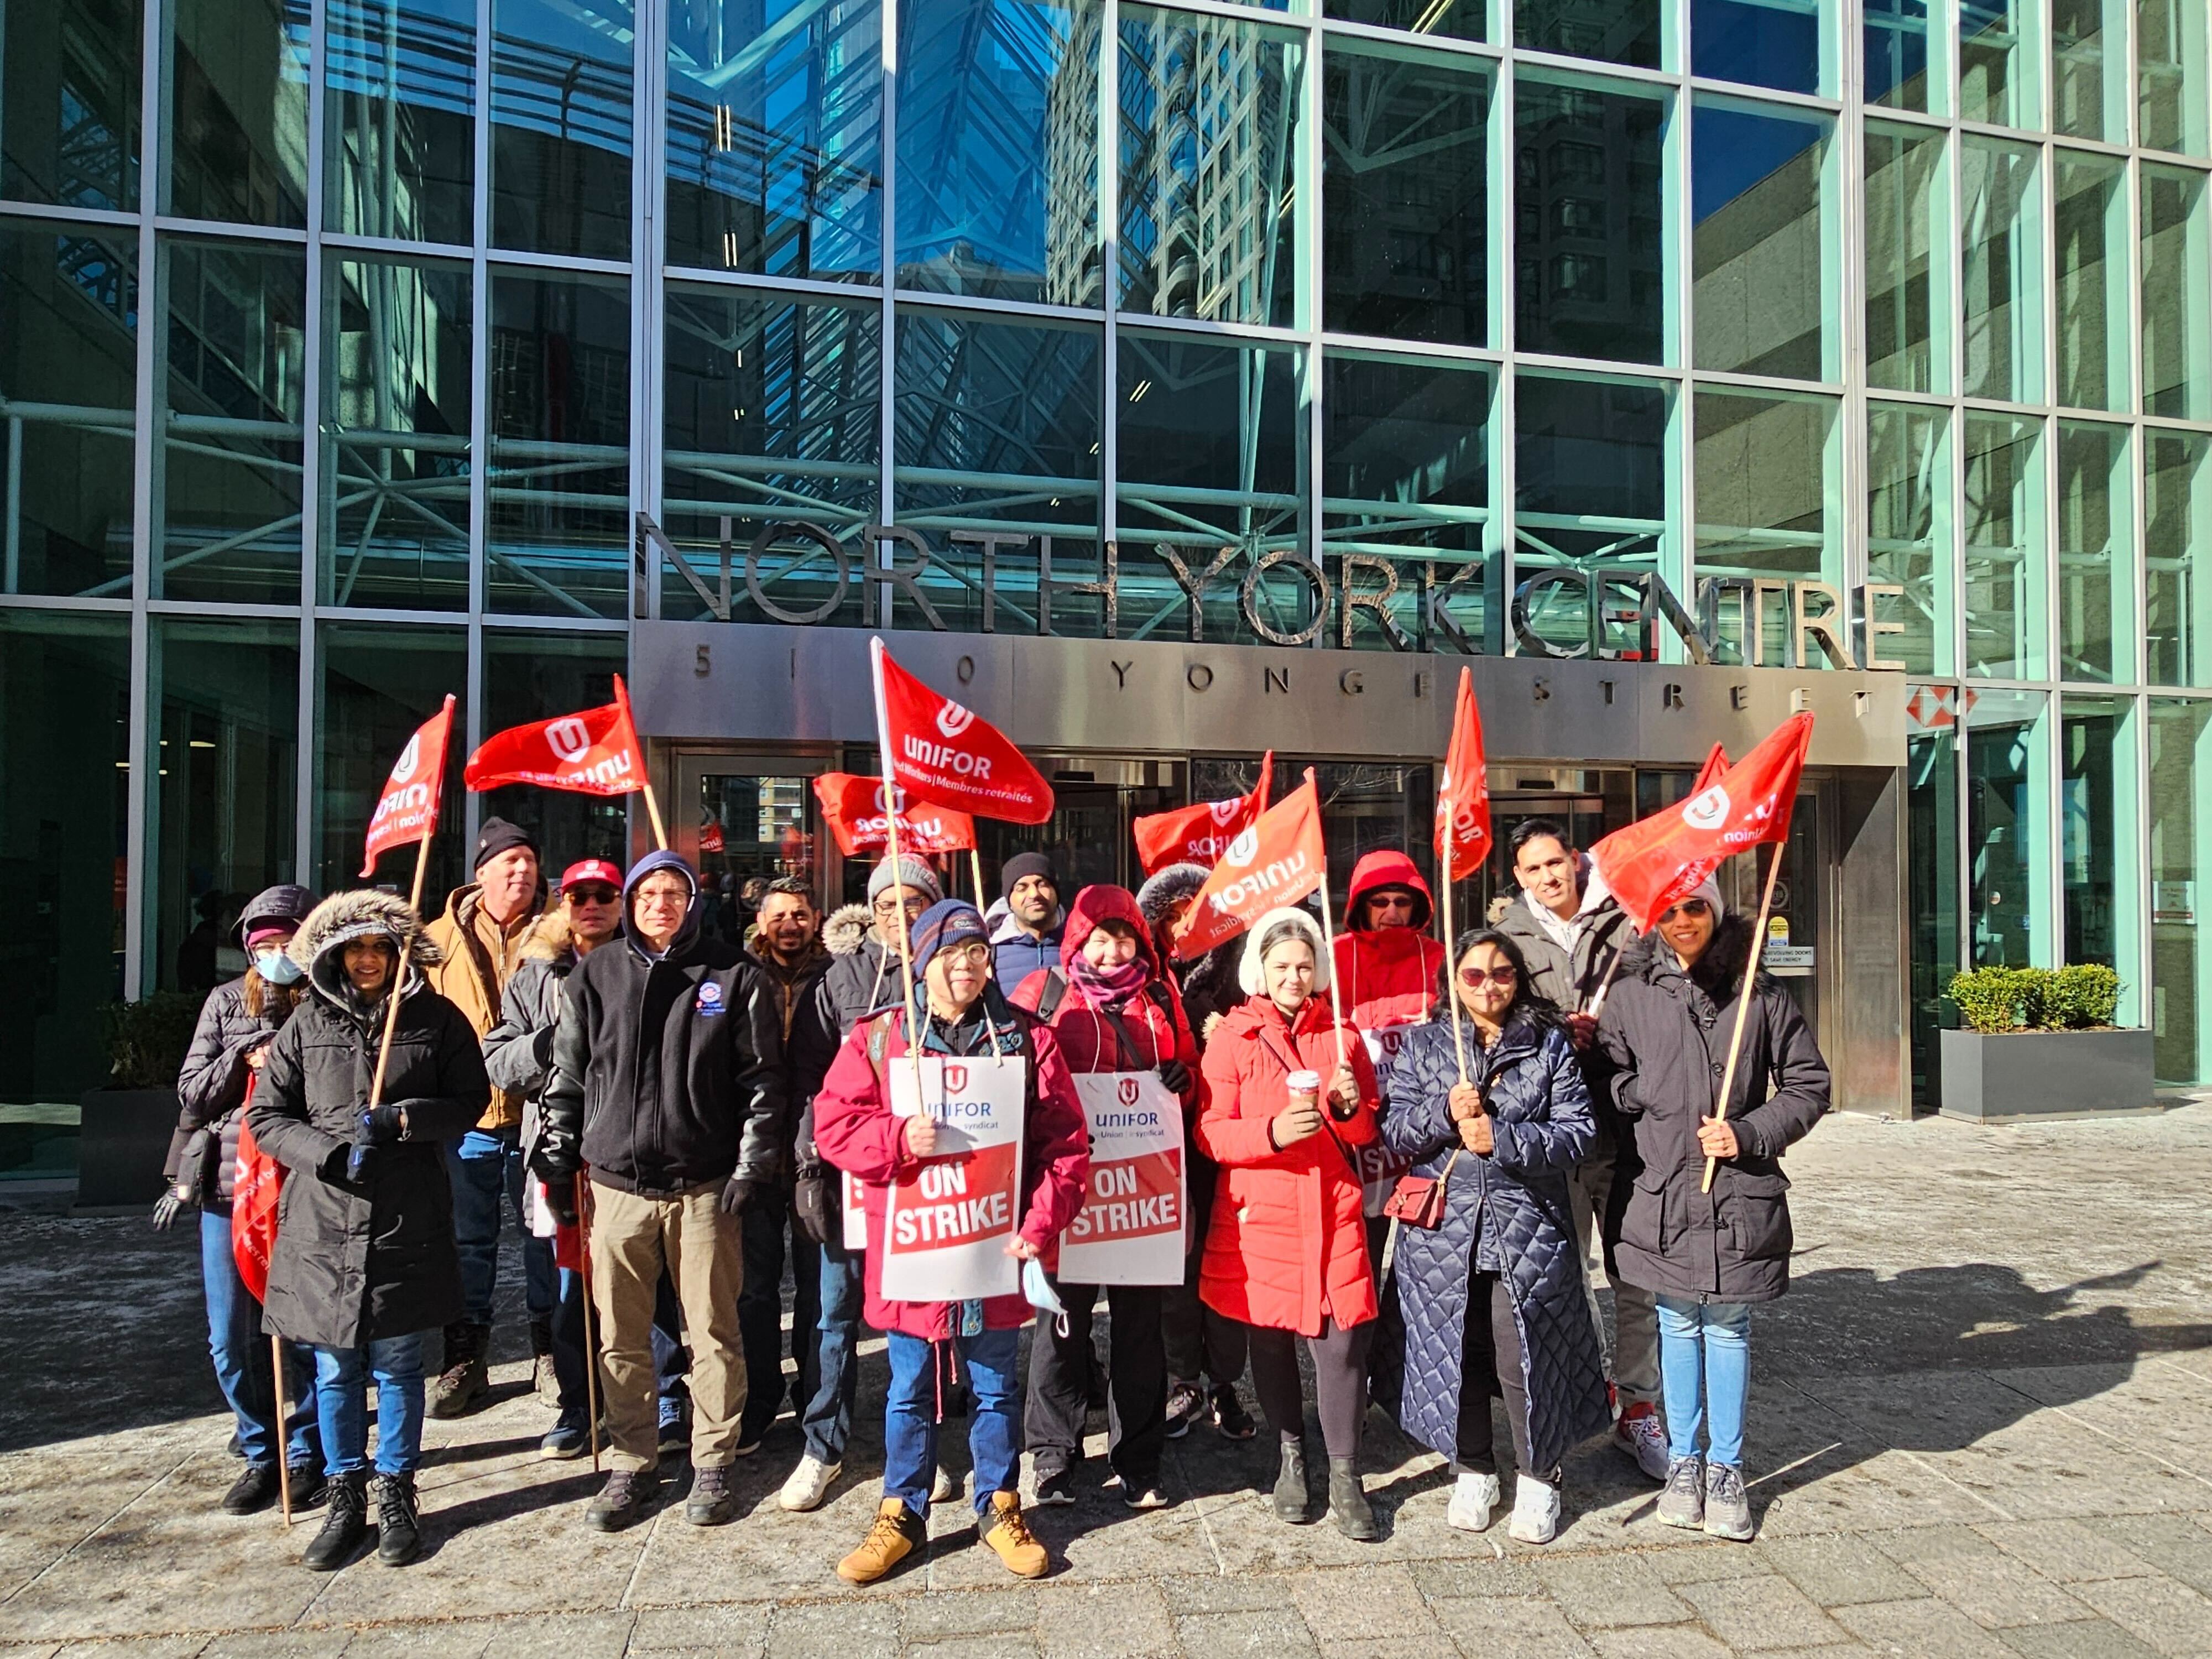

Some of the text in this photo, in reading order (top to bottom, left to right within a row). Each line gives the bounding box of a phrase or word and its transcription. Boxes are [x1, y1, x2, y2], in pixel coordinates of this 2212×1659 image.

[635, 512, 1906, 671] NORTH YORK CENTRE
[1111, 660, 1431, 698] YONGE
[1532, 676, 1874, 718] STREET
[985, 789, 1033, 804] retraités
[919, 1161, 967, 1199] ON
[1094, 1165, 1137, 1198] ON
[895, 1191, 1009, 1245] STRIKE
[1072, 1193, 1177, 1236] STRIKE
